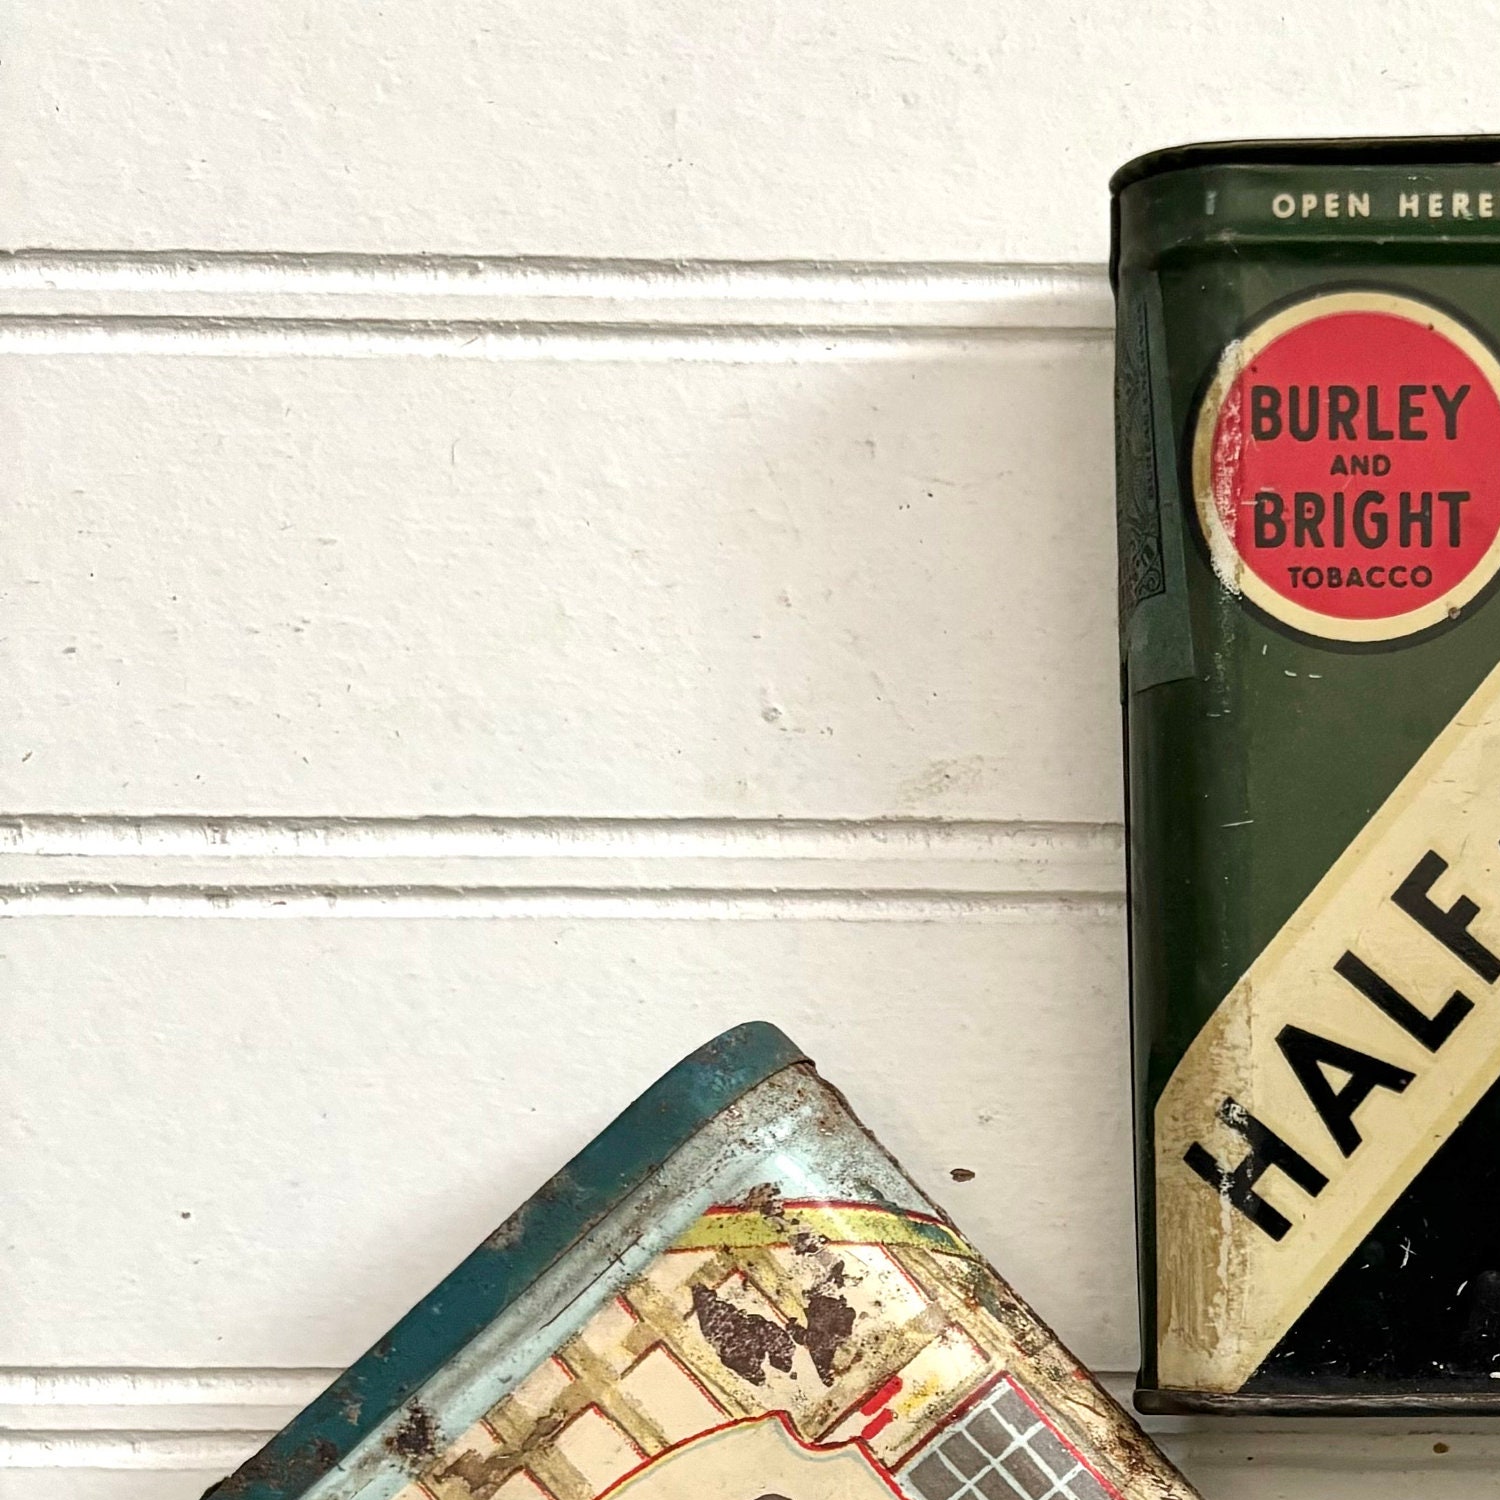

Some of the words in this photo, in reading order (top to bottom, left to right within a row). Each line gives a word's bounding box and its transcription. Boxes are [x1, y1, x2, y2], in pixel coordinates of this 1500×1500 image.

[1271, 193, 1370, 218] OPEN
[1398, 192, 1495, 218] HERE
[1250, 384, 1471, 442] BURLEY
[1330, 453, 1392, 477] AND
[1252, 490, 1471, 548] BRIGHT
[1288, 564, 1433, 589] TOBACCO
